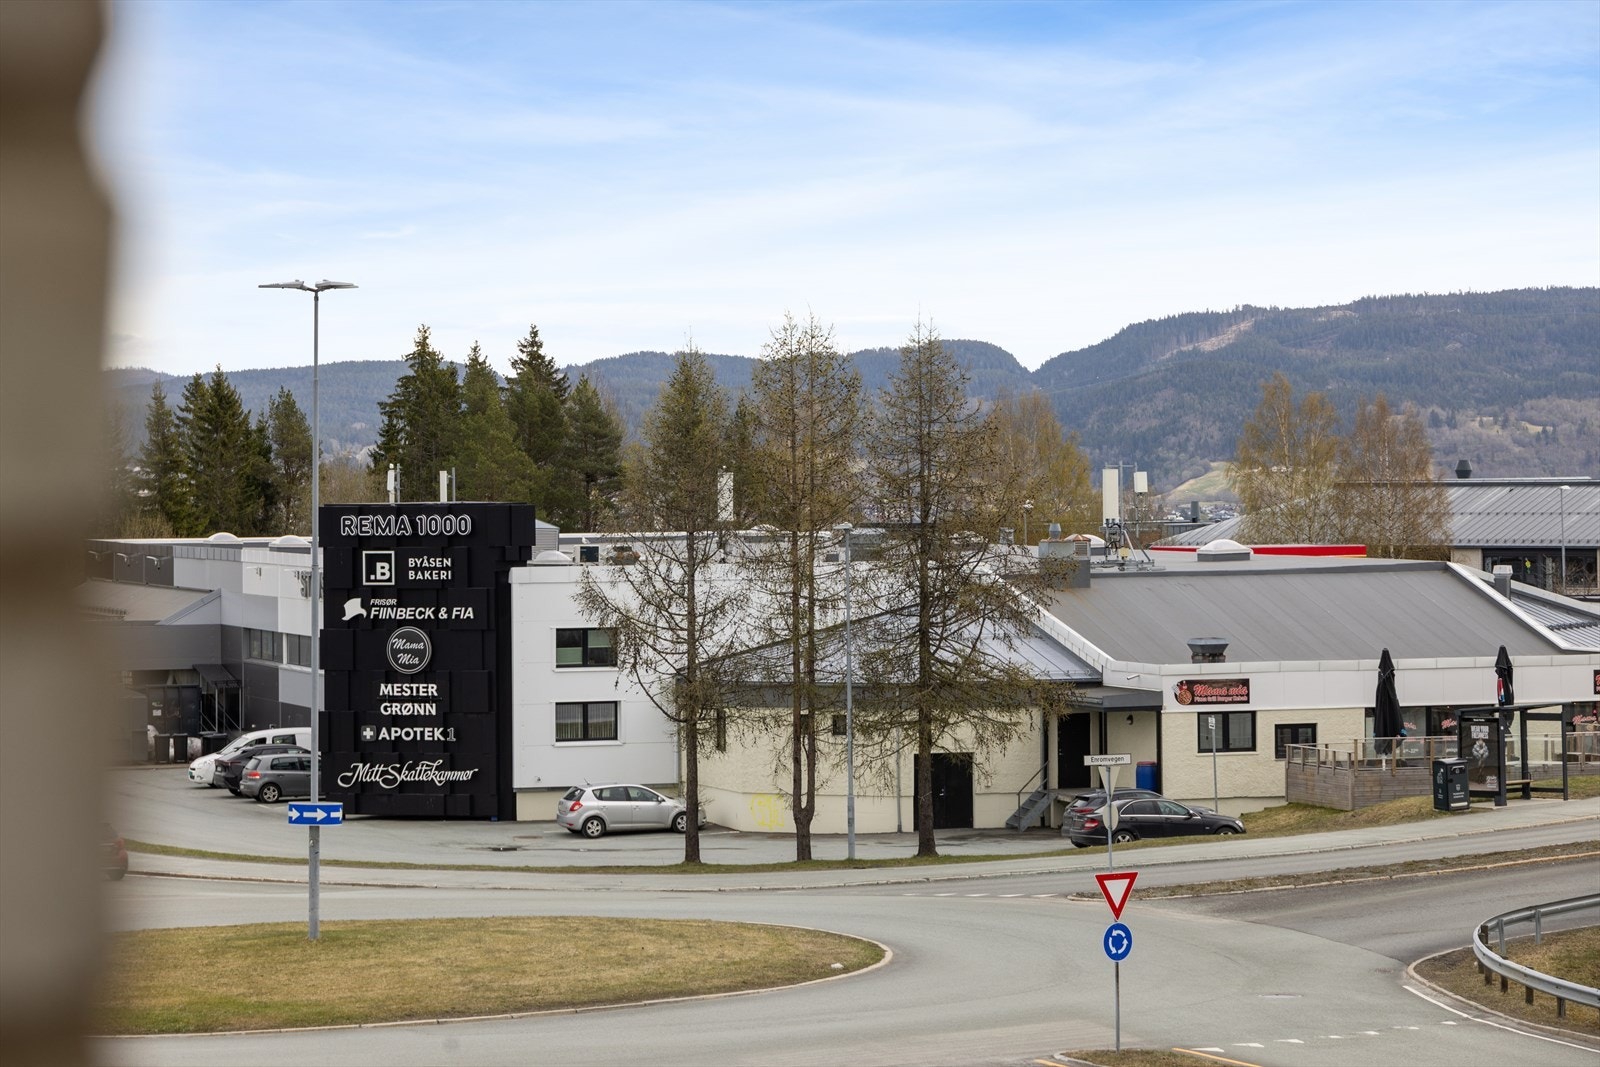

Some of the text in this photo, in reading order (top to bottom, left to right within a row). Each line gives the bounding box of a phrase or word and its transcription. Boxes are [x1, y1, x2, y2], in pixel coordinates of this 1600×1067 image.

[340, 514, 472, 536] REMA 1000
[408, 555, 452, 568] BYÅSEN
[408, 570, 452, 580] BAKERI
[370, 598, 397, 606] FRISØR
[370, 607, 475, 620] FIINBECK & FIA
[392, 638, 425, 650] Mama
[397, 653, 420, 665] Mia
[380, 683, 438, 696] MESTER
[380, 702, 437, 716] GRØNN
[338, 760, 479, 789] Mitt Skattekammer
